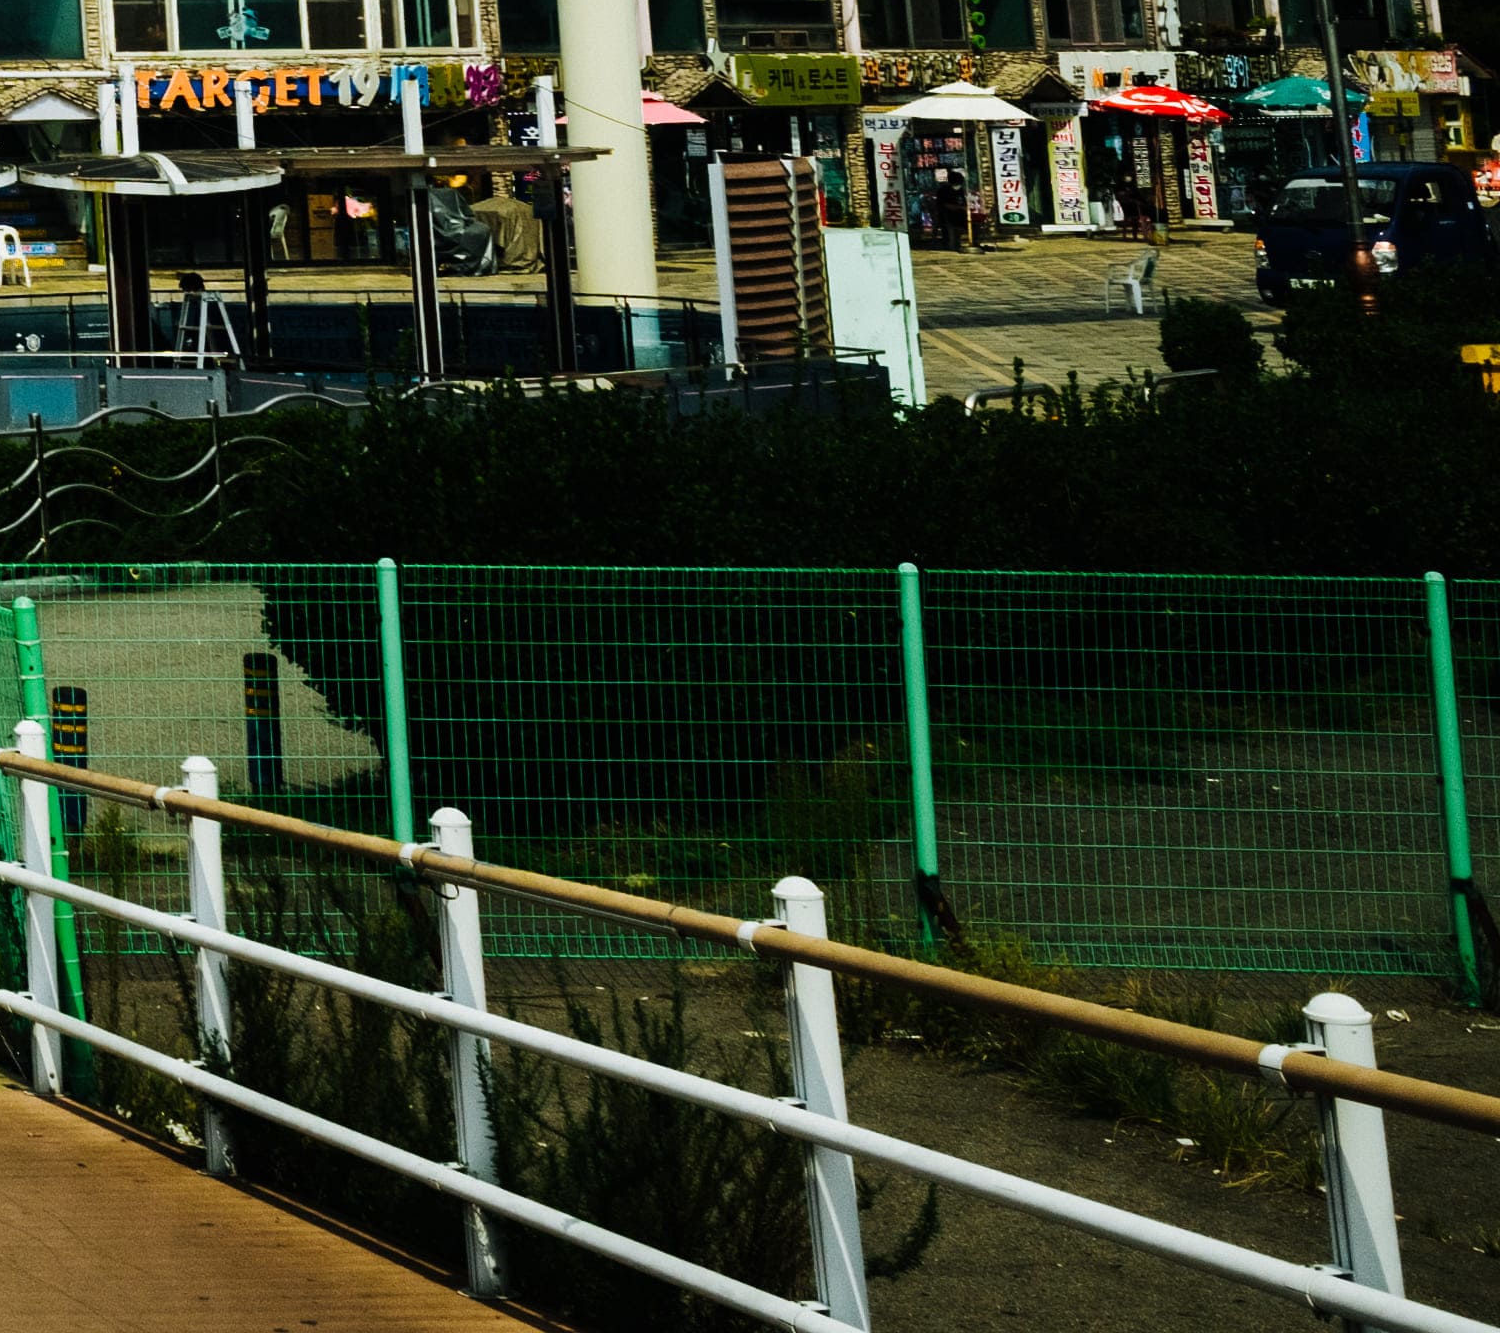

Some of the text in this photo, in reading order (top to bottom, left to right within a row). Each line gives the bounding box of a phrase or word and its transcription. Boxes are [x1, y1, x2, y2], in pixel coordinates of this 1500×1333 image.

[136, 69, 327, 113] TARGET
[328, 64, 381, 108] 19
[768, 68, 796, 92] 커피
[808, 68, 849, 90] 토스트
